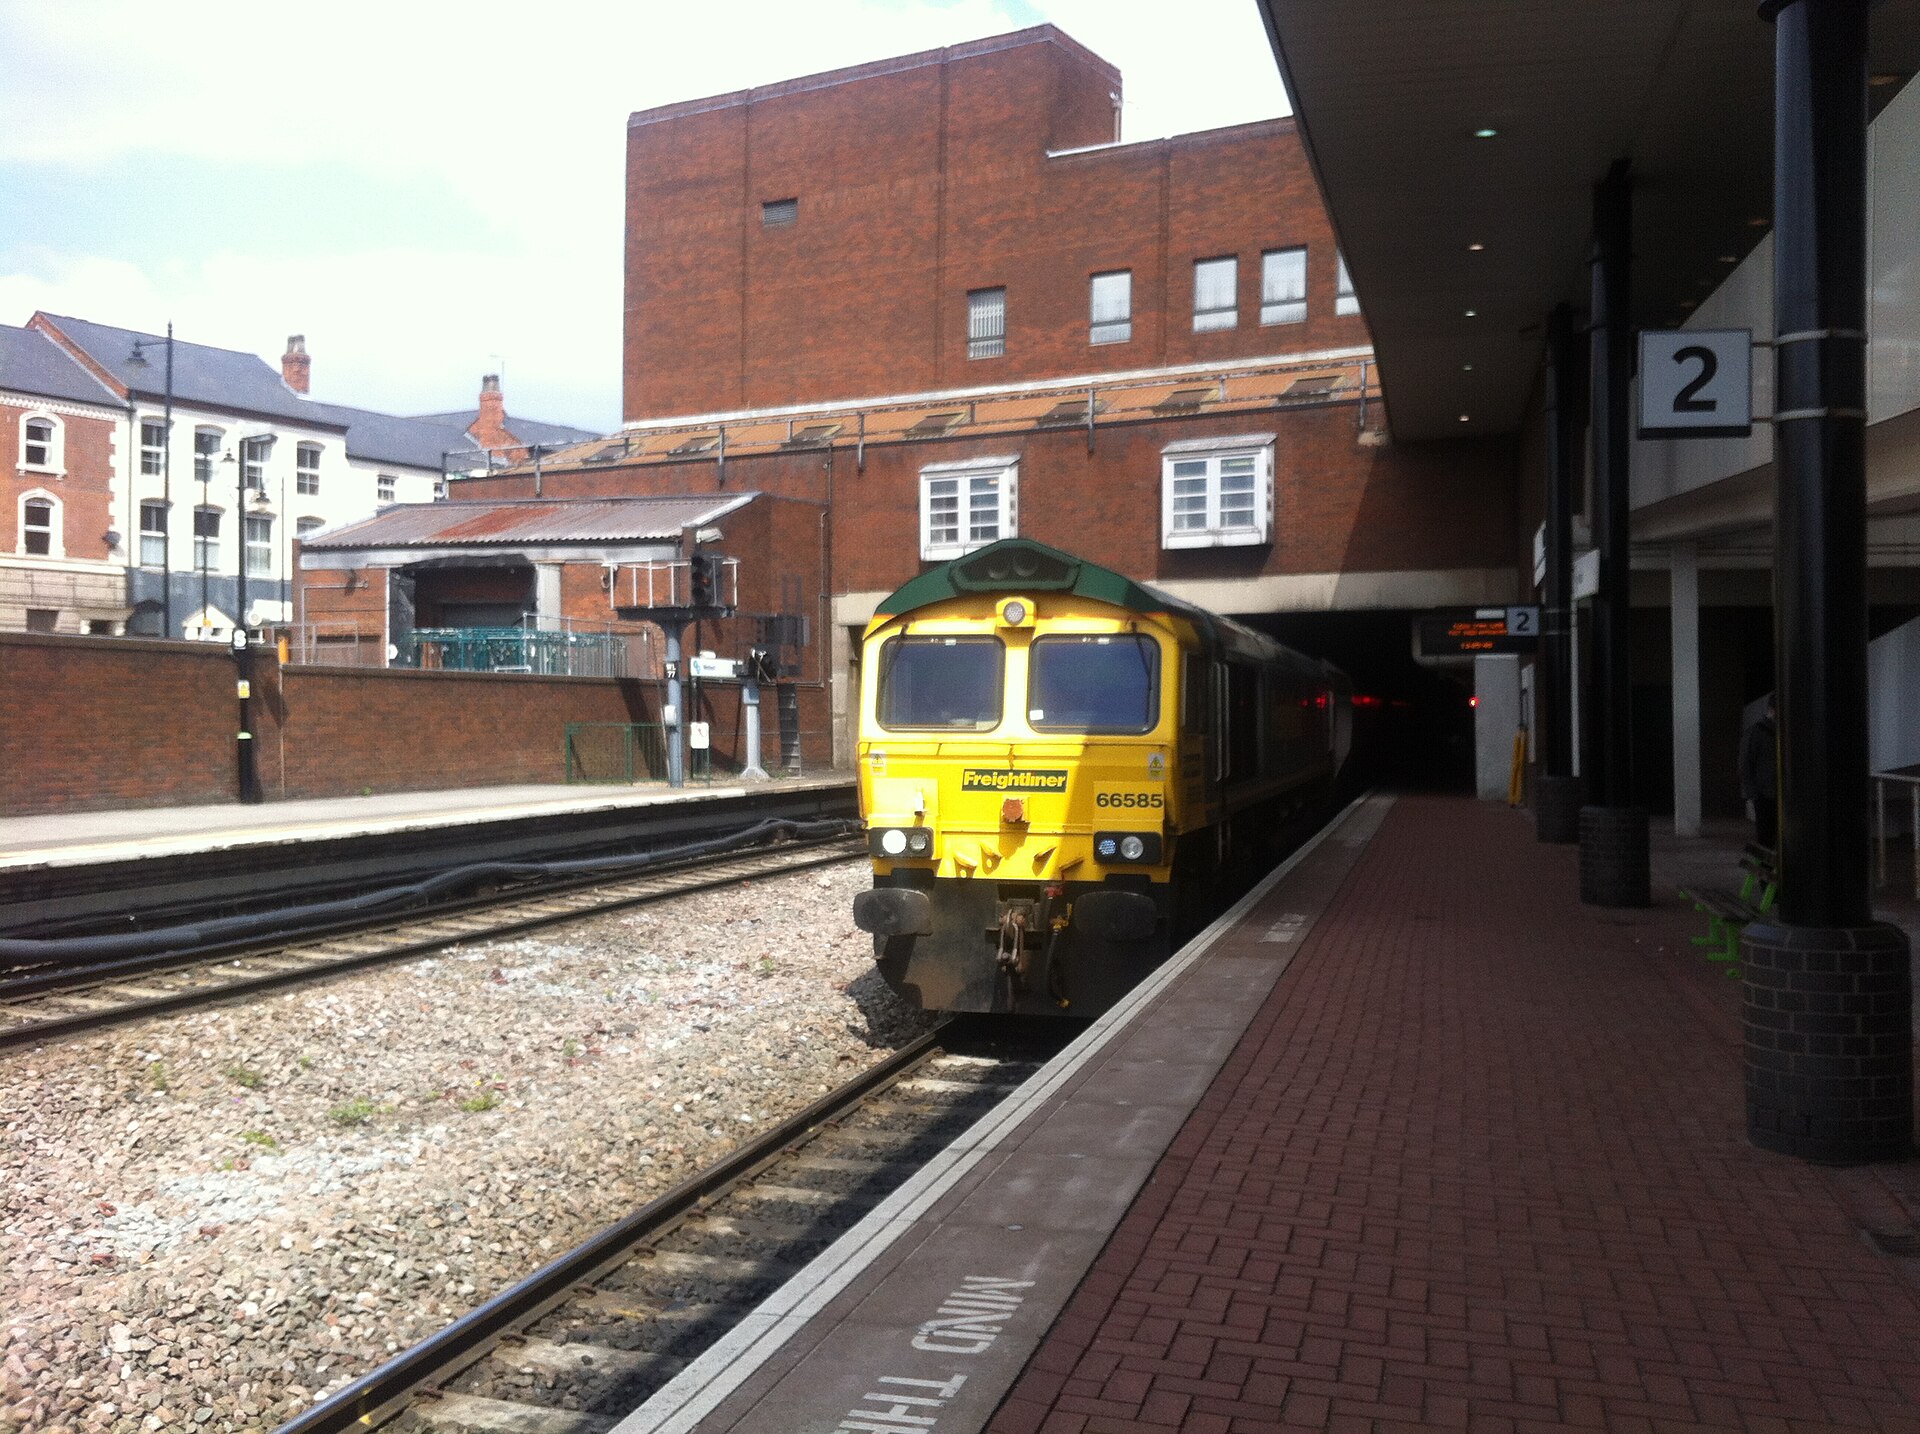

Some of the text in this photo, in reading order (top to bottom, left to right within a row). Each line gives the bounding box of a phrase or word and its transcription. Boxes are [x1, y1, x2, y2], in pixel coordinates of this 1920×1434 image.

[1672, 345, 1719, 413] 2
[1516, 611, 1531, 631] 2
[963, 770, 1066, 789] Freightliner
[1096, 793, 1164, 808] 66585
[912, 1275, 1036, 1354] MIND
